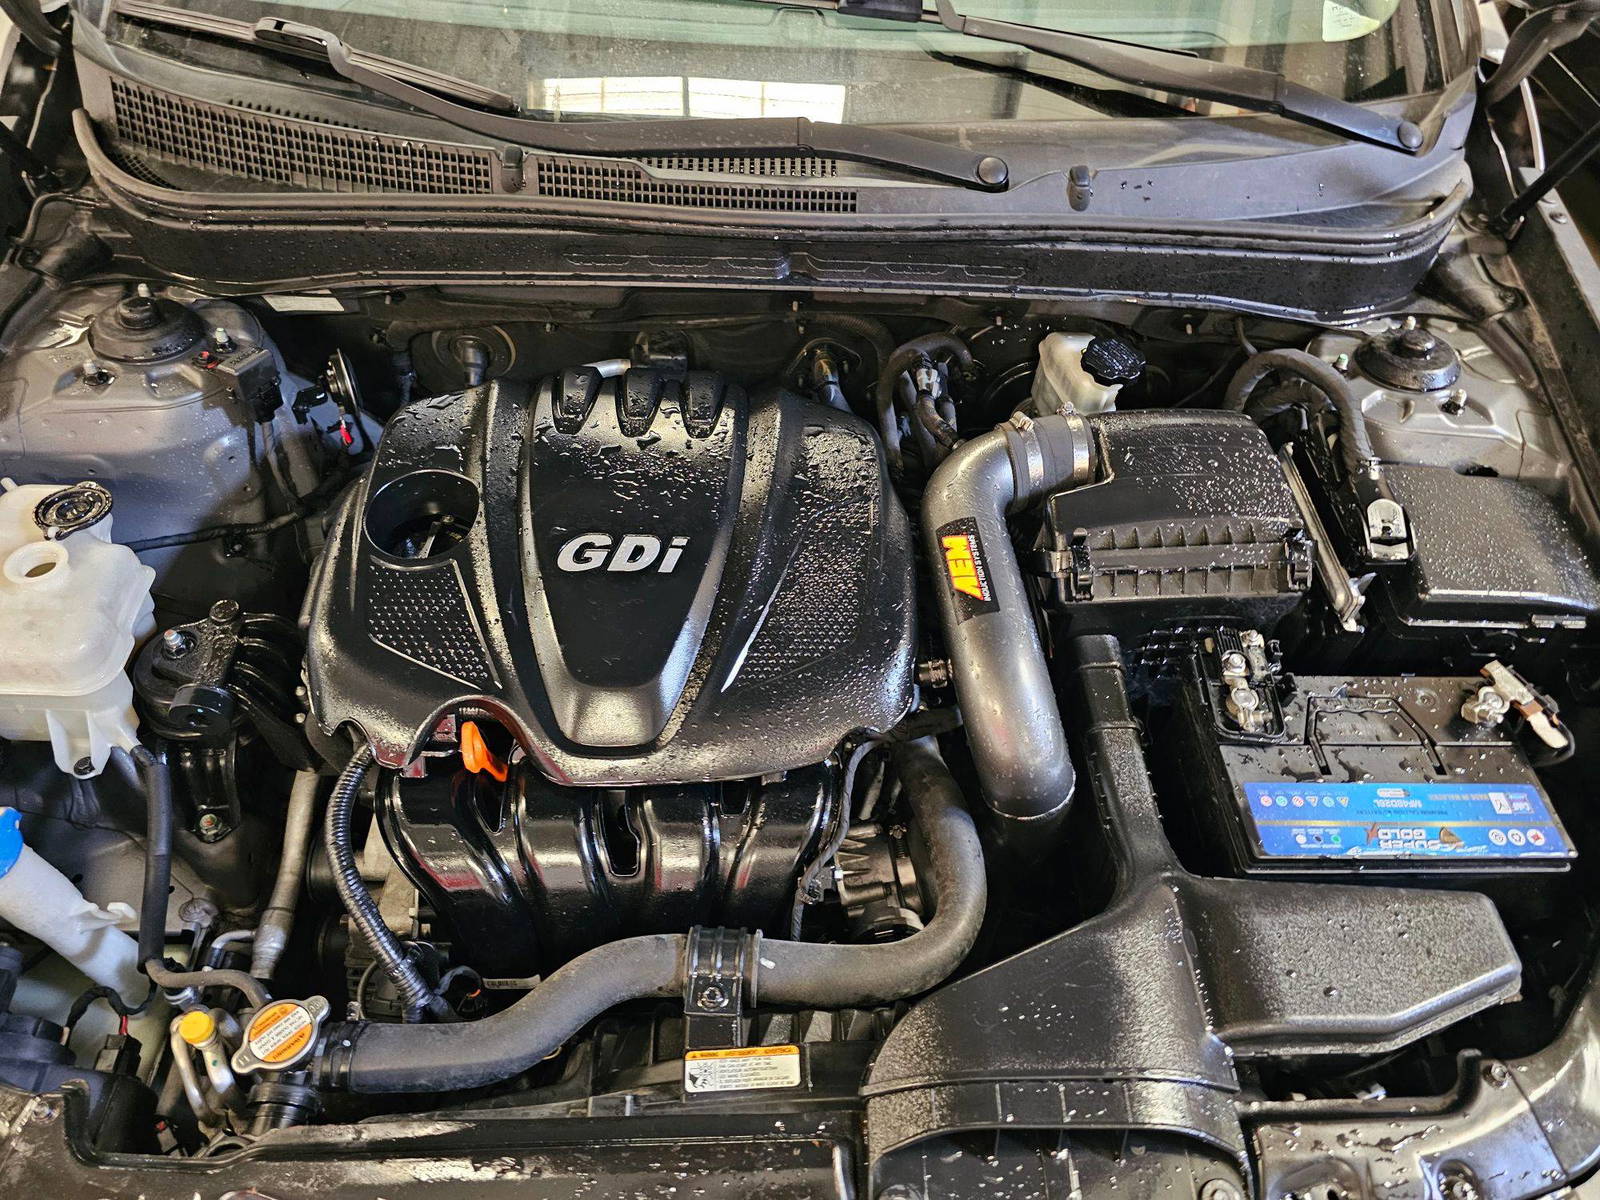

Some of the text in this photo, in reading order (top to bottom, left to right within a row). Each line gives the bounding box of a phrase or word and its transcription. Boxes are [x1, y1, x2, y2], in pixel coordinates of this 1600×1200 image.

[556, 532, 690, 573] GDi
[941, 533, 985, 601] AEM
[975, 566, 993, 602] INDUCTION
[1378, 828, 1426, 840] GOLD
[1380, 839, 1442, 850] SUPER
